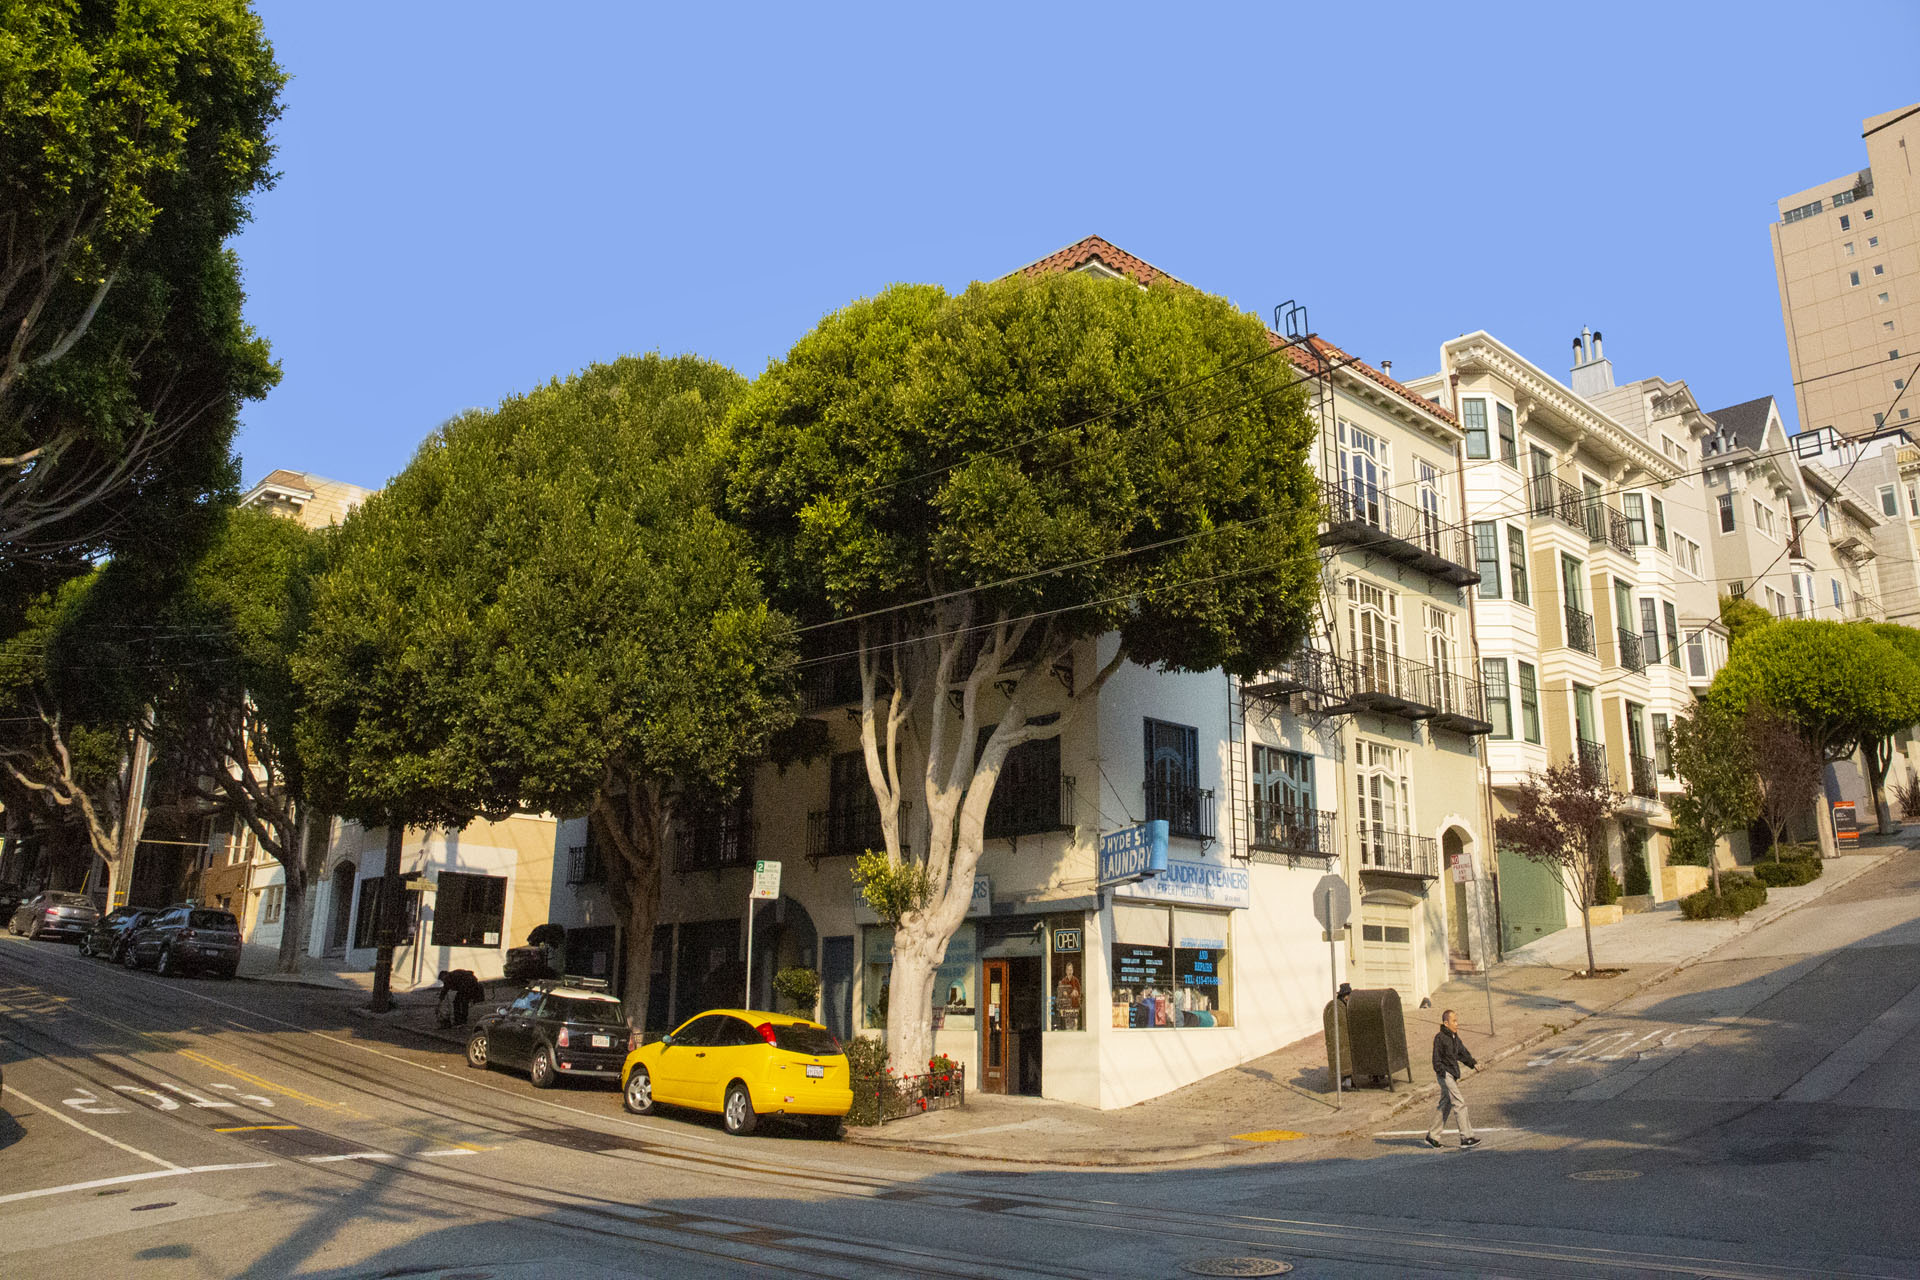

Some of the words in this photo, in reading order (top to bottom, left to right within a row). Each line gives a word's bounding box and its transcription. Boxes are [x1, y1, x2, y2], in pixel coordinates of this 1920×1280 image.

[1107, 832, 1131, 853] HYDE
[1134, 827, 1149, 846] ST.
[758, 863, 764, 871] 2
[1102, 843, 1154, 880] LAUNDRY
[1160, 864, 1199, 884] LAUNDRY
[1206, 870, 1248, 890] CLEANERS
[1057, 933, 1079, 949] OPEN
